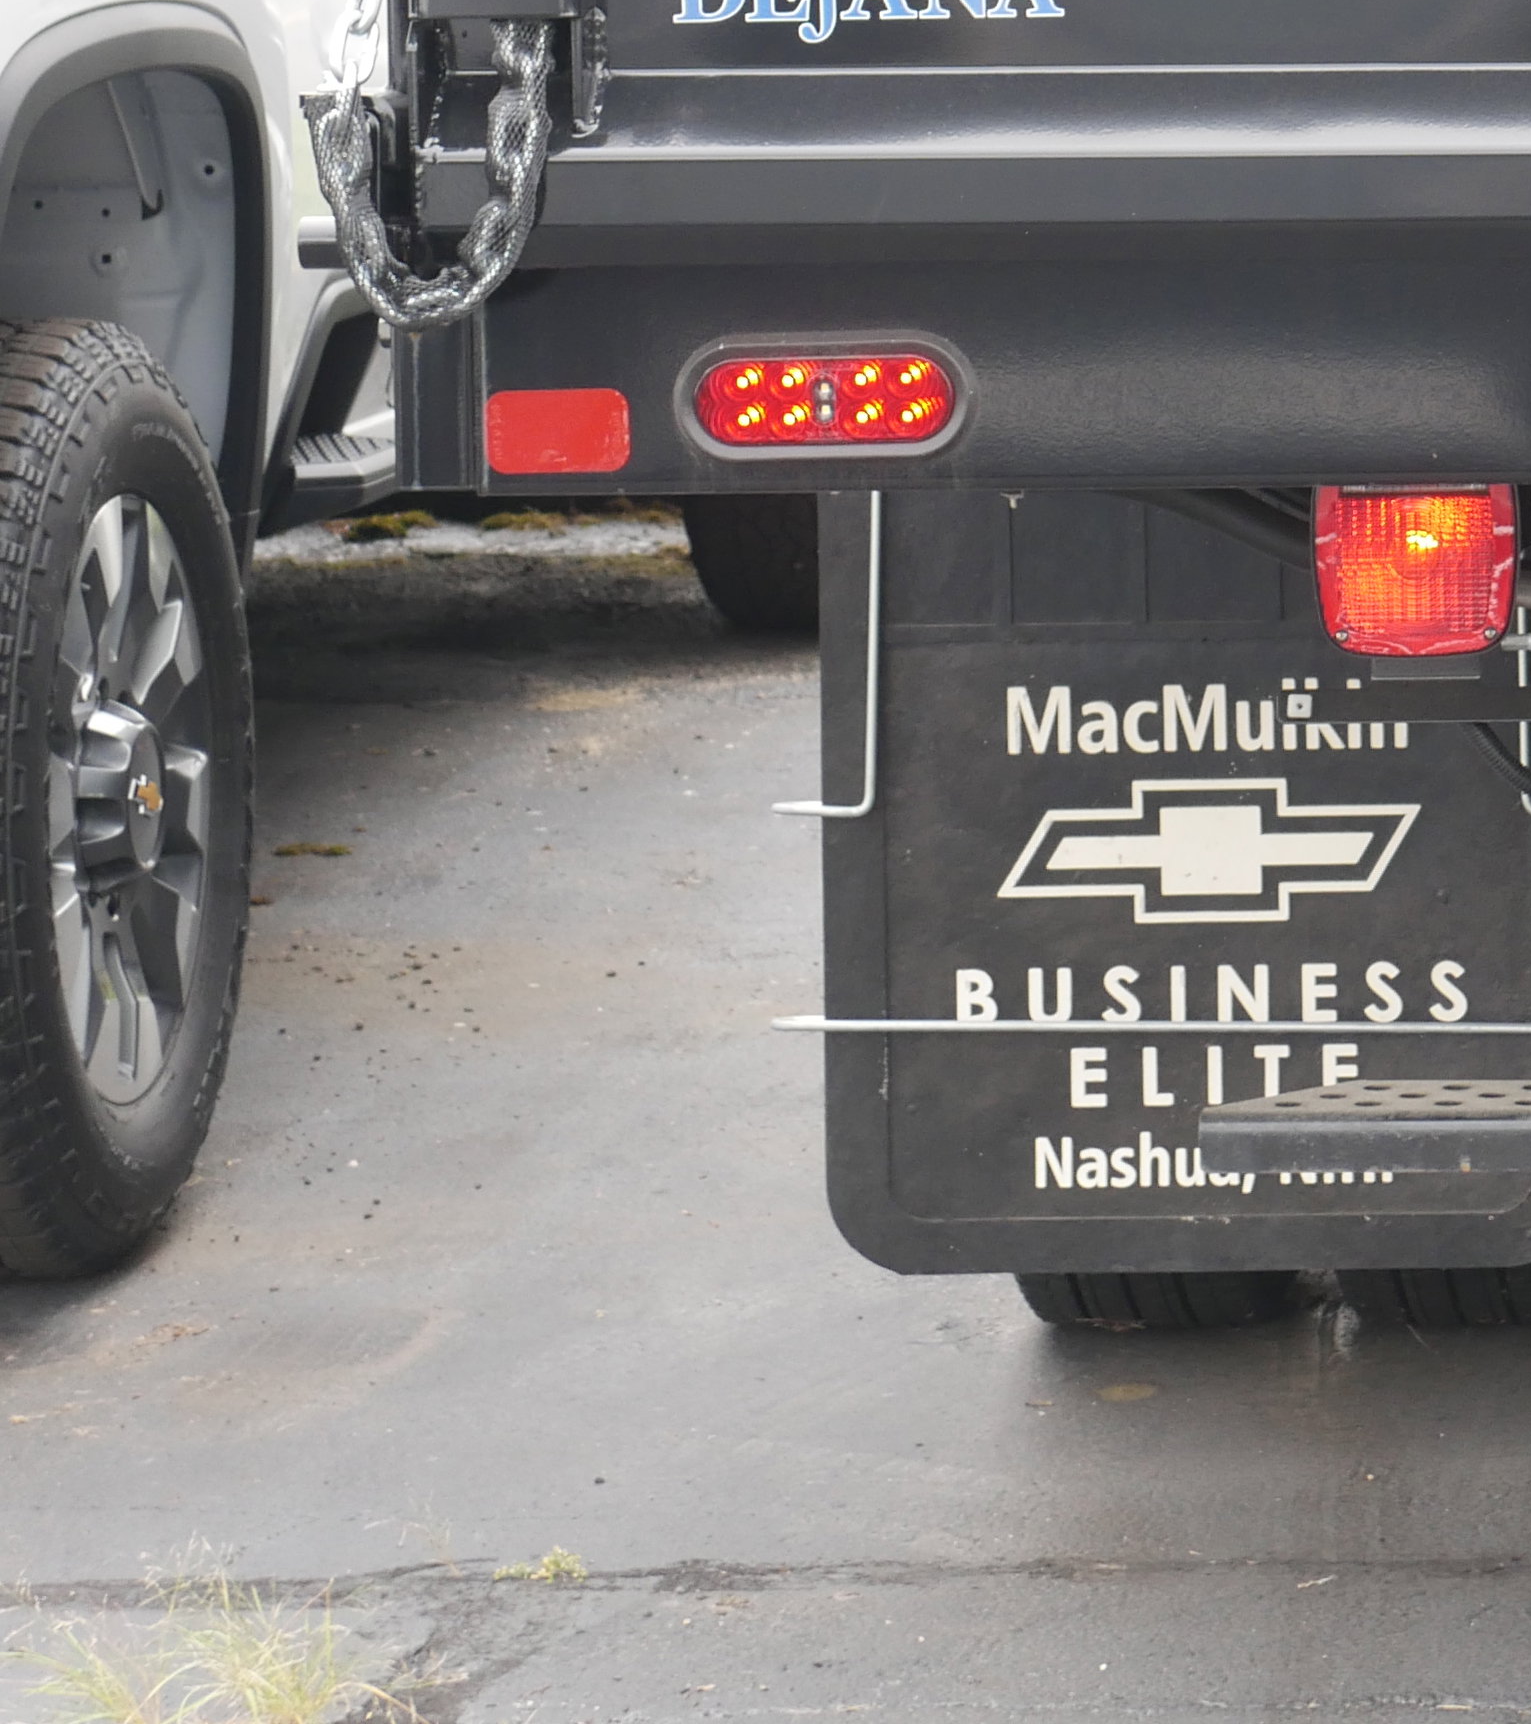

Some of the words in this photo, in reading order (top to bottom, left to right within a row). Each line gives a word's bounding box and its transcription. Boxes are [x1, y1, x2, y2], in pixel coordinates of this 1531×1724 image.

[956, 960, 1469, 1023] BUSINESS
[1070, 1043, 1359, 1109] ELITE
[1034, 1130, 1256, 1195] Nashu,
